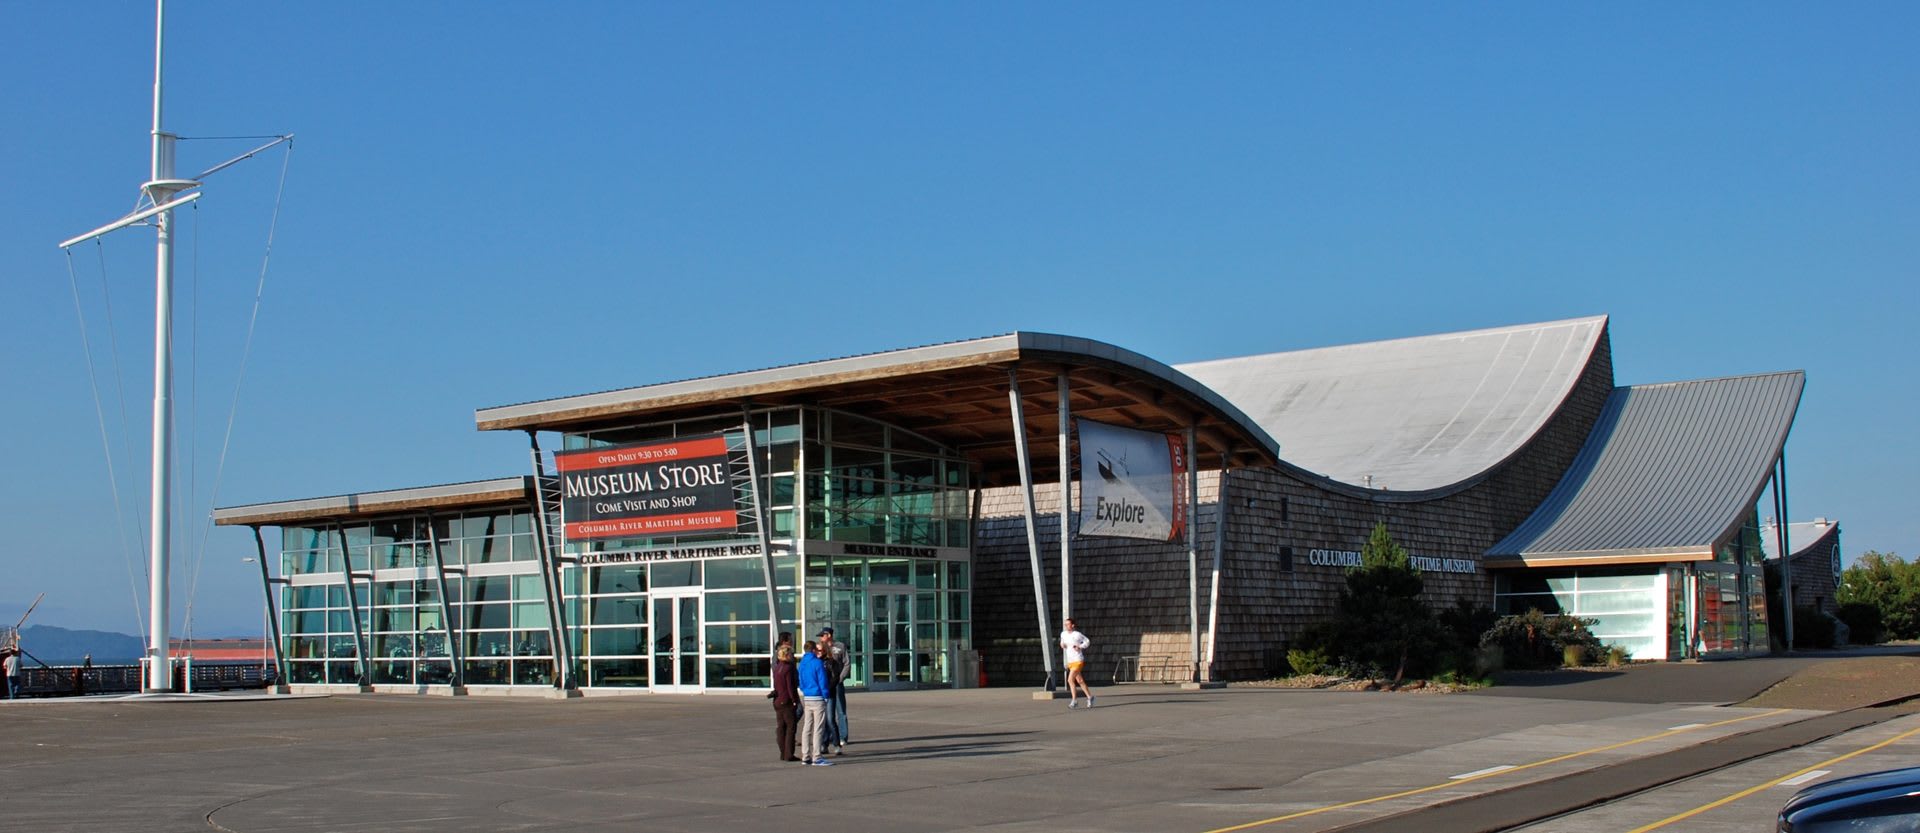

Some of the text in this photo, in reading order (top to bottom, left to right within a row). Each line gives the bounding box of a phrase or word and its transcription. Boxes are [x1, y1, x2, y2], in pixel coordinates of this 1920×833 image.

[637, 451, 652, 459] 9:30
[664, 448, 678, 457] 5:00
[1173, 445, 1182, 466] 50
[566, 463, 725, 498] MUSEUM STORE
[595, 495, 697, 514] COME VISIT AND SHOP
[1096, 496, 1145, 527] Explore
[578, 516, 722, 533] COLUMBIA RIVER MARITIME MUSEUM
[580, 544, 777, 564] COLUMBIA RIVER MARITIME MUSE
[886, 545, 937, 558] ENTRANCE
[1309, 549, 1363, 567] COLUMBIA
[1442, 558, 1476, 574] MUSEUM
